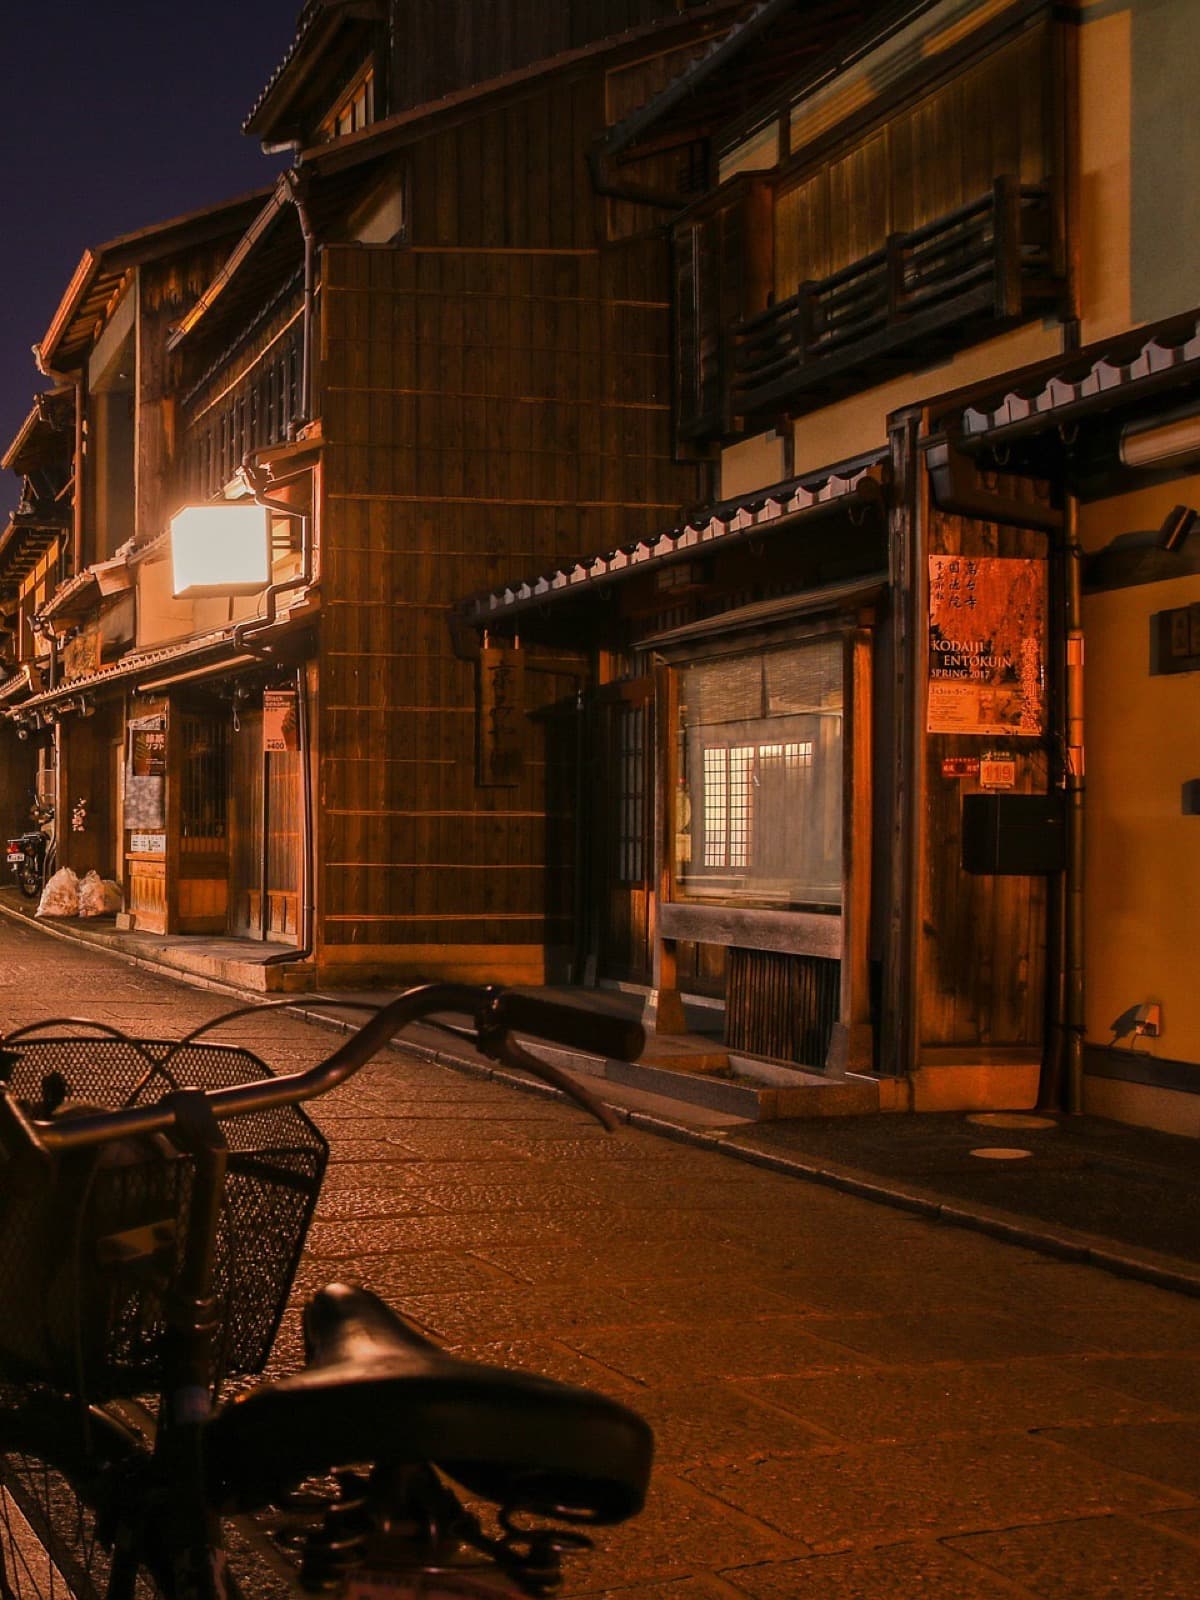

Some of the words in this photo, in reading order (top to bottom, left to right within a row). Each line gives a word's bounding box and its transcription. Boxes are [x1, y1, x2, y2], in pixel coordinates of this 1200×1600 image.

[932, 639, 985, 653] KODAIJI
[944, 654, 1012, 668] ENTOKUIN
[930, 668, 968, 679] SPRING
[969, 669, 991, 680] 2017
